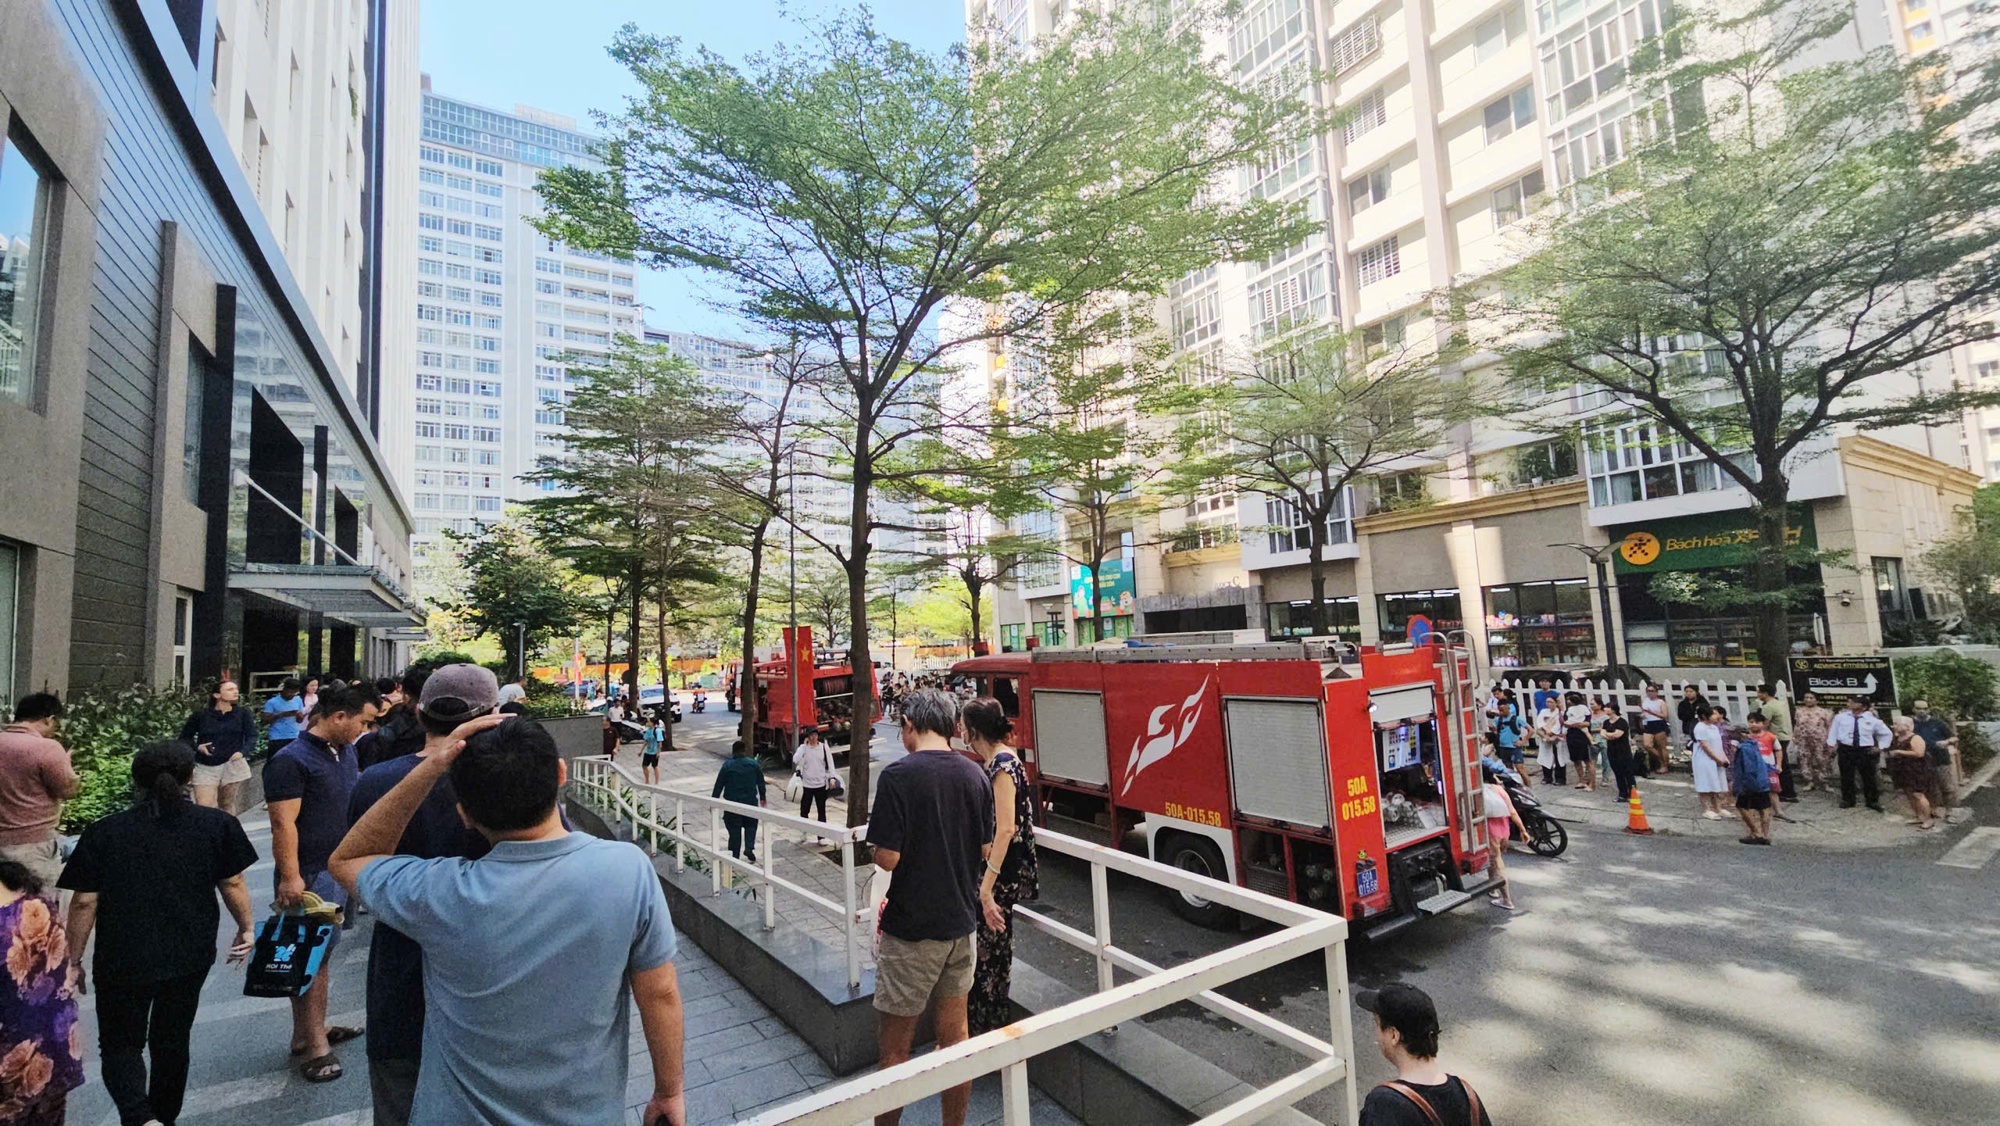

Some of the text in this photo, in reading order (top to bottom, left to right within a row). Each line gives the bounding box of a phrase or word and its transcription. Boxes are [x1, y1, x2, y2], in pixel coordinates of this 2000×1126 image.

[1808, 677, 1858, 686] Block B
[1347, 775, 1368, 797] 50A
[1165, 802, 1222, 826] 50A-015.58
[1342, 796, 1376, 821] 015.58
